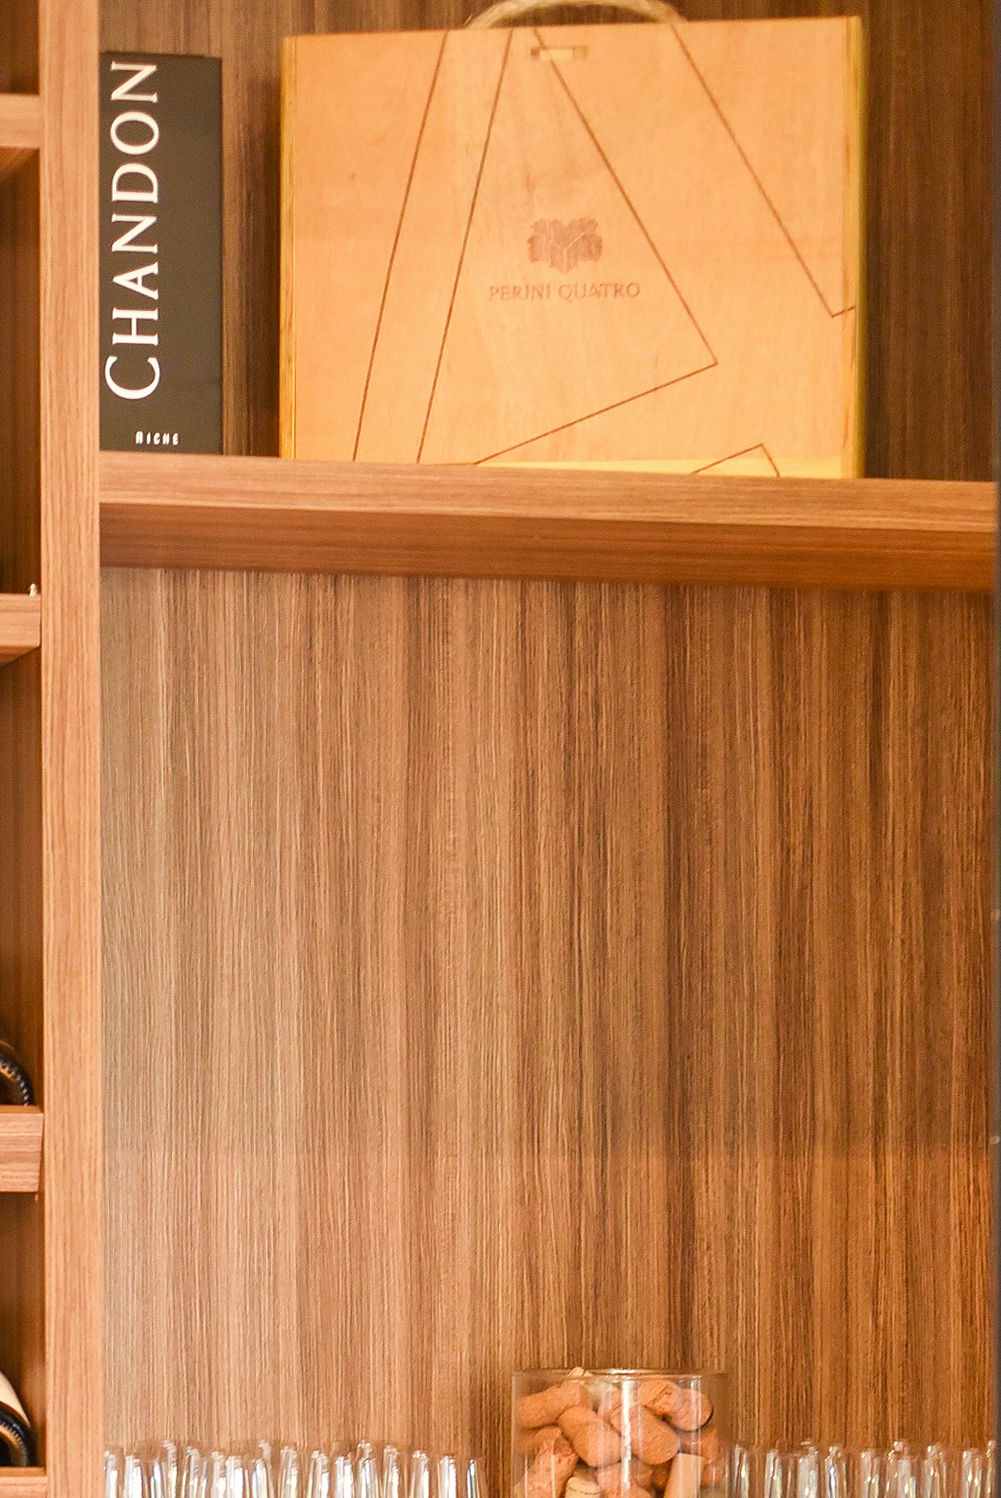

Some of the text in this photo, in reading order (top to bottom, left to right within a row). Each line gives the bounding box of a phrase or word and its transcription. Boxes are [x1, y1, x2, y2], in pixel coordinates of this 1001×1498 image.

[104, 60, 161, 400] CHANDON
[488, 282, 641, 303] PERINI QUATRO
